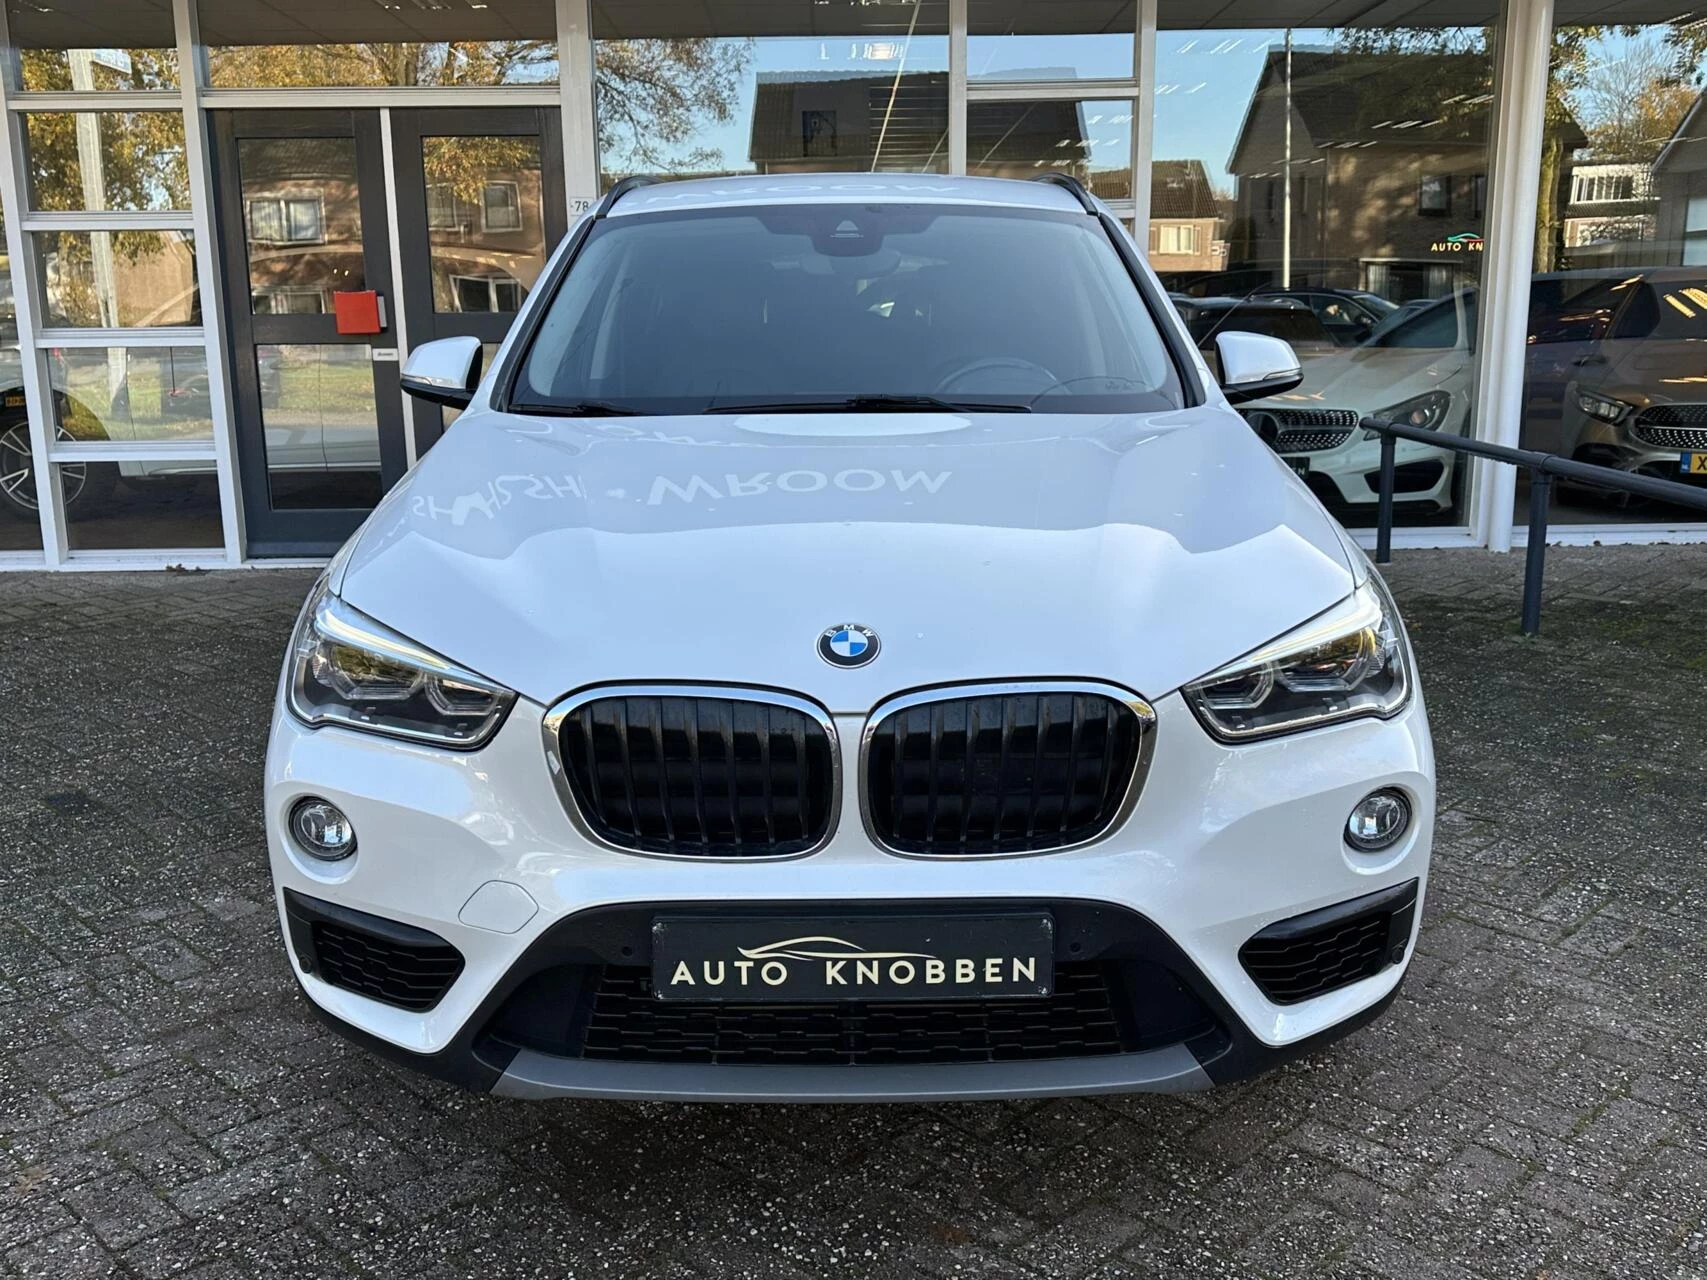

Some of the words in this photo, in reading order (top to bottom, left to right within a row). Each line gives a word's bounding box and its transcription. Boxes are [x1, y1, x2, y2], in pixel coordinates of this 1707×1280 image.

[1430, 242, 1461, 251] AUTO
[824, 624, 875, 637] BMW
[671, 960, 788, 985] AUTO
[825, 957, 1036, 985] KNOBBEN
